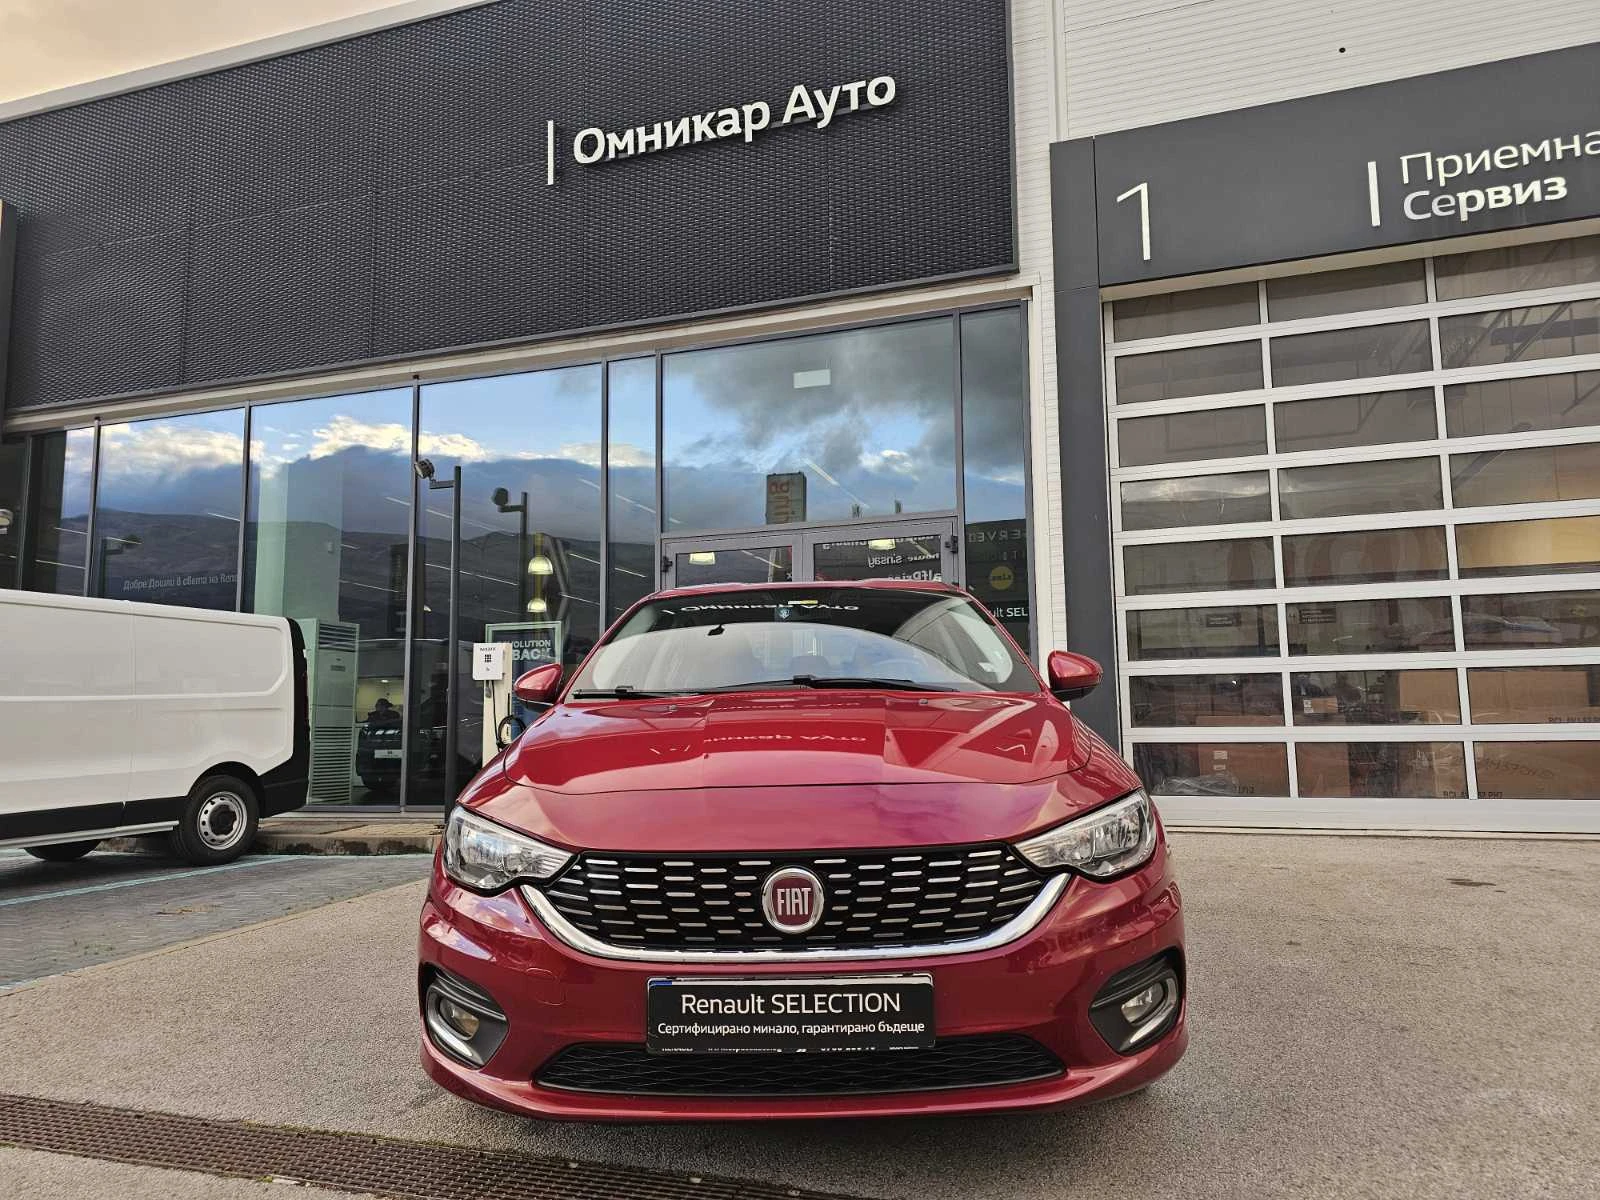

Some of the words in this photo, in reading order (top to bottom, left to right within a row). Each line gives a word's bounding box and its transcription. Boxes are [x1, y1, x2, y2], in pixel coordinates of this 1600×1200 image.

[573, 101, 771, 164] Омникар
[782, 76, 896, 129] Ауто
[1400, 130, 1600, 187] Приемна
[1116, 182, 1151, 261] 1
[1403, 176, 1567, 222] Сервиз
[776, 887, 812, 916] FIAT
[681, 993, 766, 1015] Renault
[771, 992, 901, 1014] SELECTION
[657, 1022, 751, 1036] Сертифицирано
[753, 1024, 800, 1036] минало,
[801, 1023, 876, 1036] гарантирано
[878, 1020, 925, 1034] бъдеще
